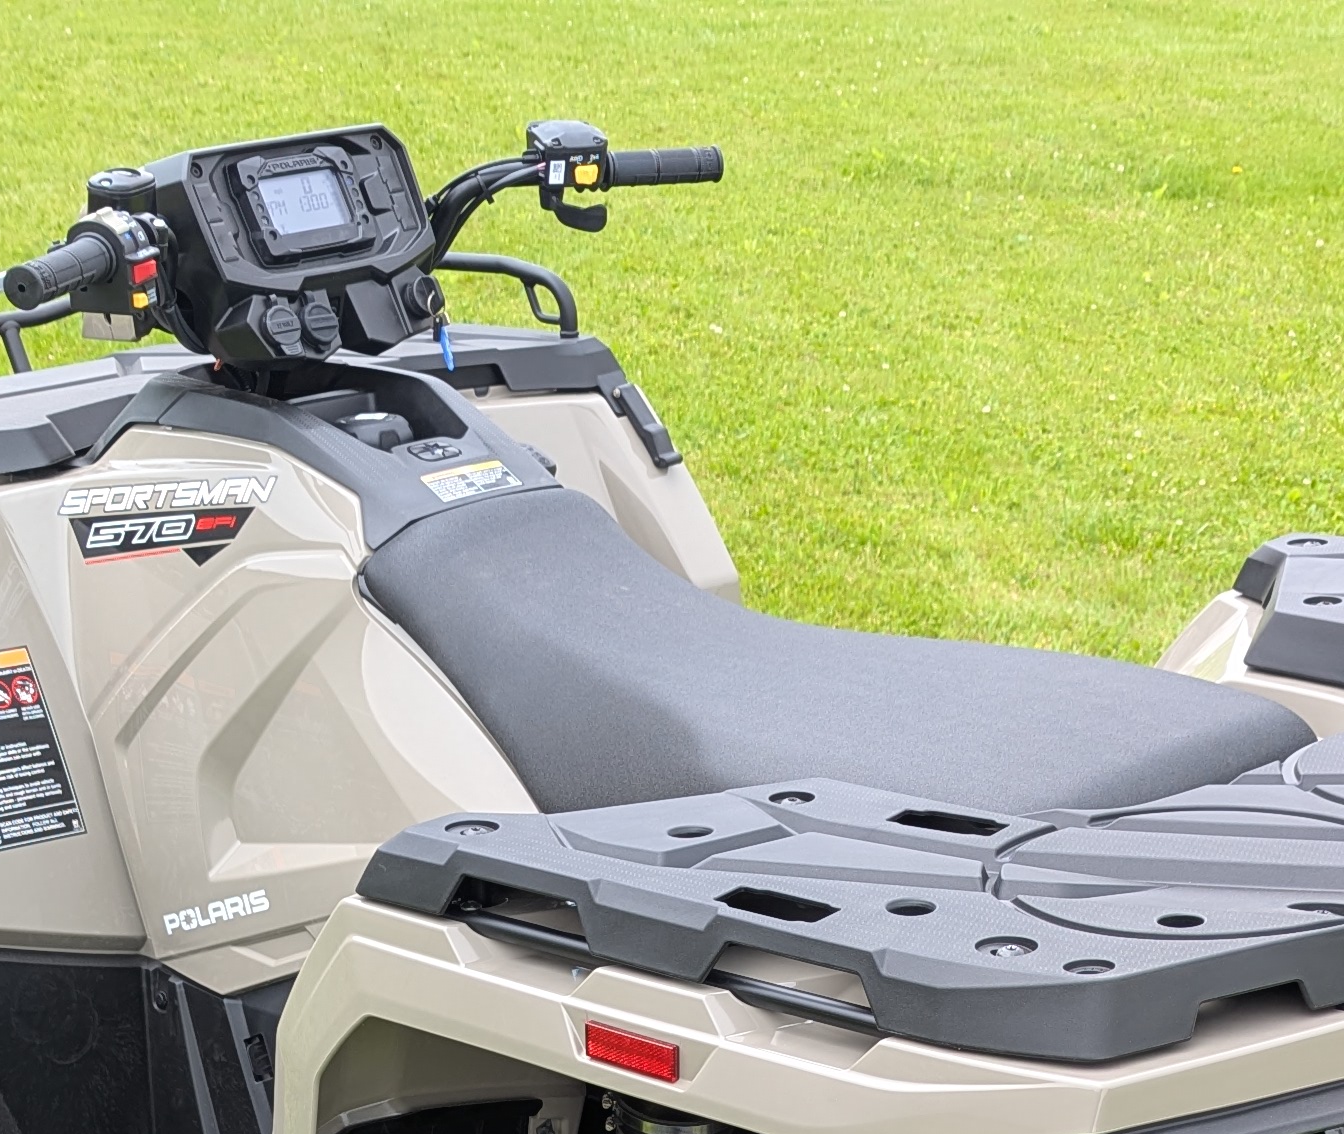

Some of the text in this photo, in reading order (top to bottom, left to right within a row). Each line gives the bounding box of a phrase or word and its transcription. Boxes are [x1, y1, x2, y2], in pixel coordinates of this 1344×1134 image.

[271, 156, 319, 170] POLARIS
[58, 475, 277, 516] SPORTSMAN
[86, 513, 238, 548] 570 EFI
[163, 888, 270, 936] POLARIS
